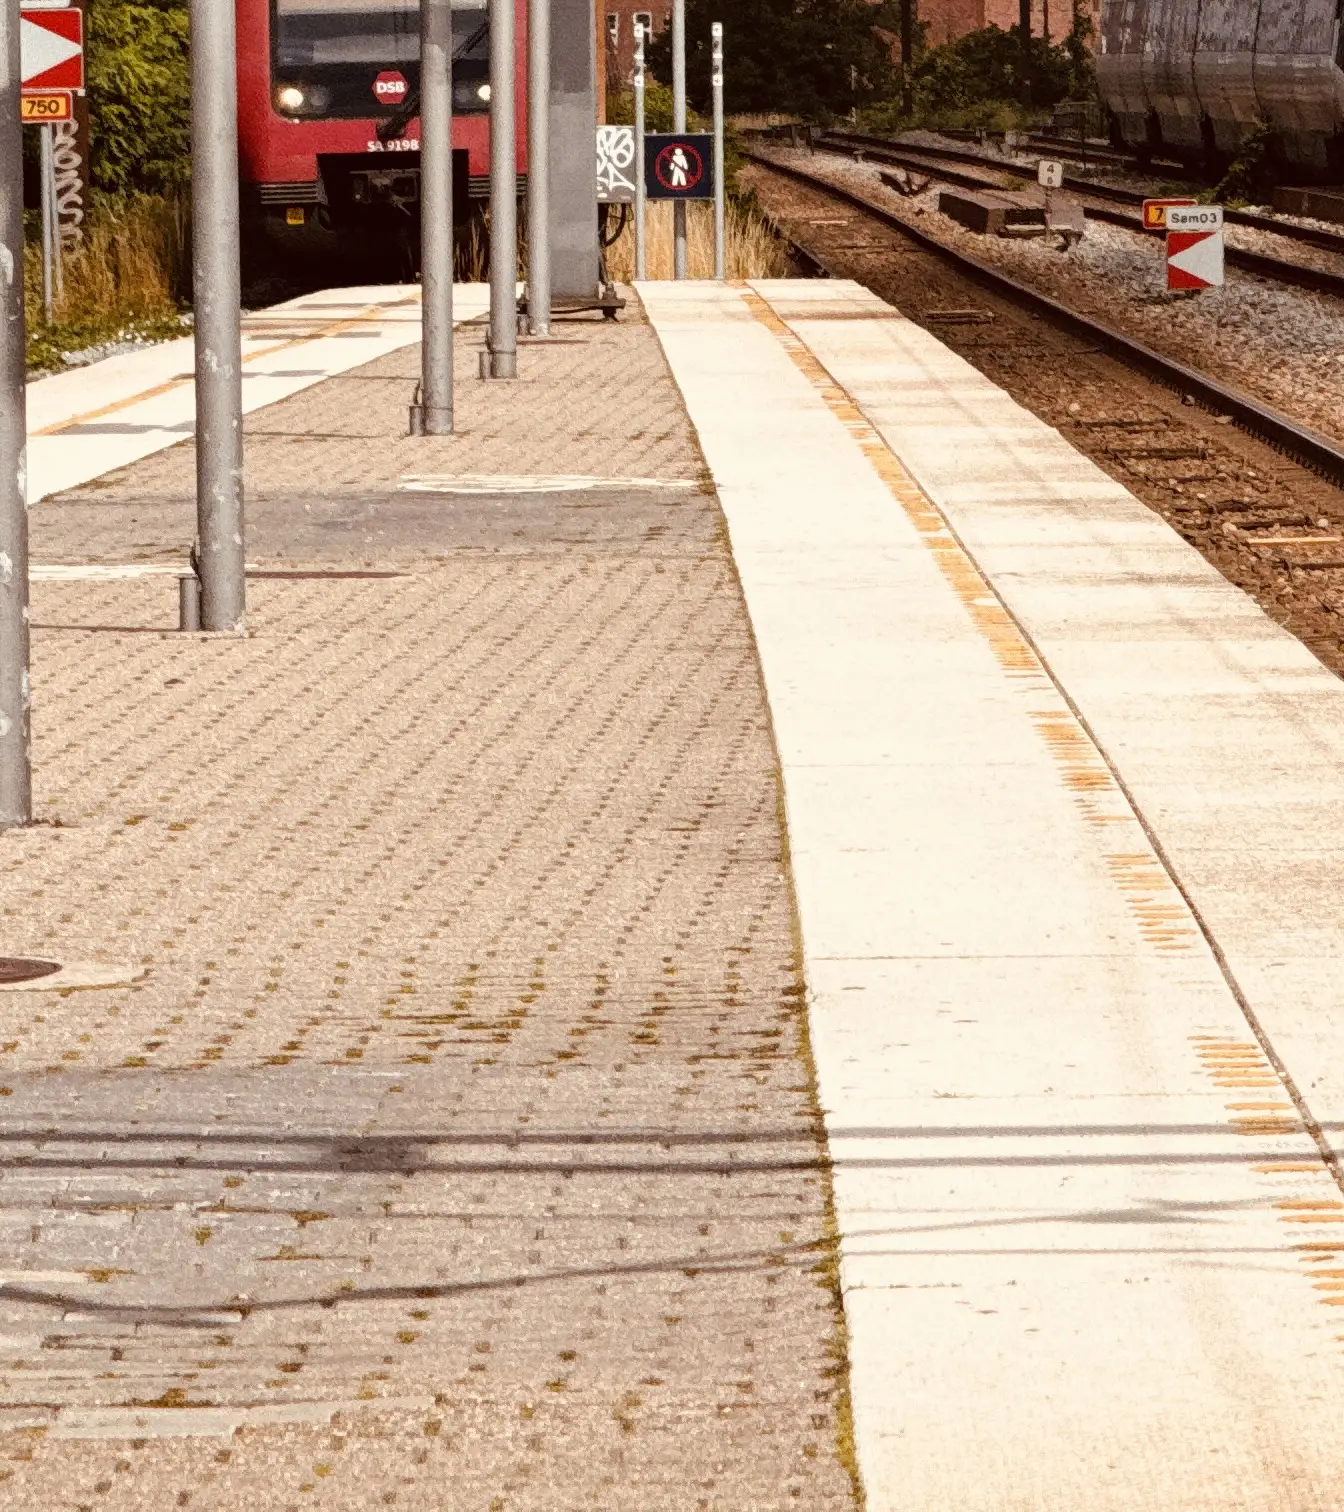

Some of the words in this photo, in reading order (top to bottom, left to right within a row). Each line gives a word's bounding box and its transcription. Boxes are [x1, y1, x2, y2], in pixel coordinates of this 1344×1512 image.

[376, 81, 405, 94] DSB
[26, 99, 60, 115] 750
[367, 140, 385, 152] SA
